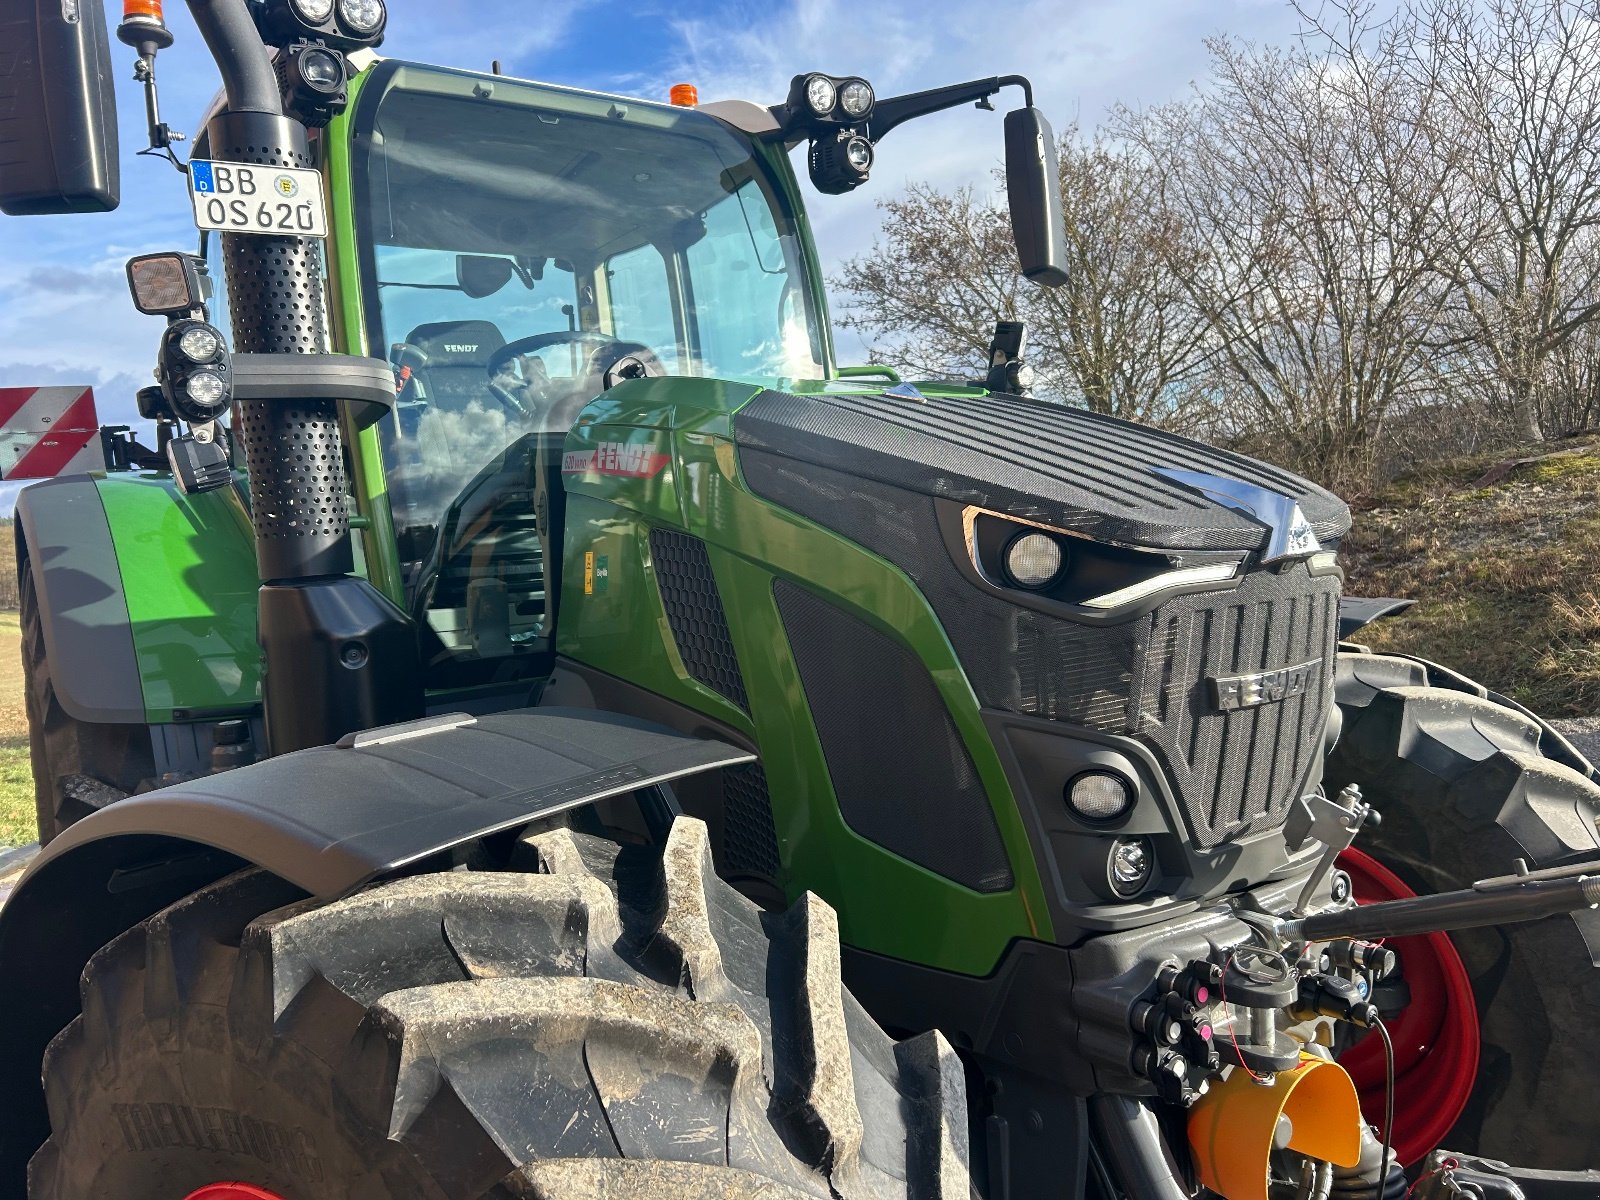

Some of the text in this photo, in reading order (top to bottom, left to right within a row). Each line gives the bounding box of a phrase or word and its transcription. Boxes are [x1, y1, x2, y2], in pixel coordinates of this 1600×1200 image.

[200, 181, 208, 190] D
[214, 166, 257, 196] BB
[207, 198, 314, 231] OS 620
[444, 344, 479, 353] FENDT
[564, 455, 575, 470] 620
[597, 441, 657, 474] FENDT
